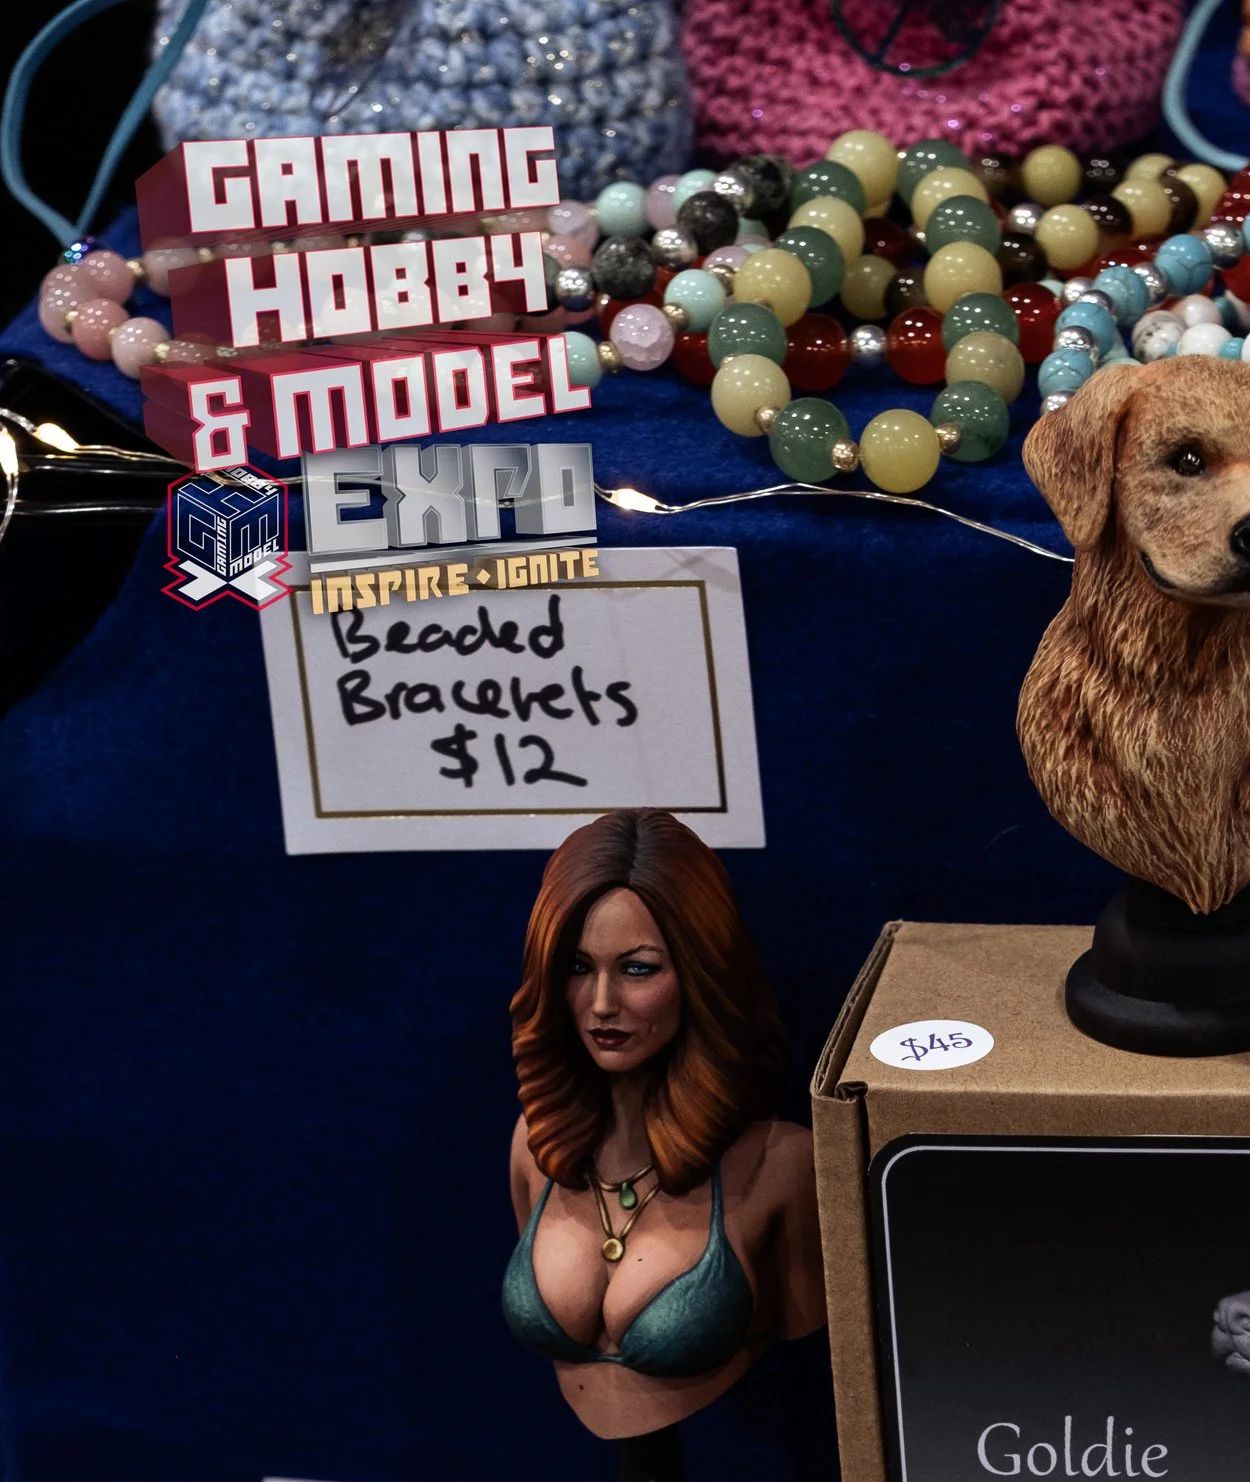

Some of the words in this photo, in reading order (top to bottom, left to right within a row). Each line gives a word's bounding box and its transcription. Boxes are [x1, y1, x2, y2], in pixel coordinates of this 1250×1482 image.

[331, 594, 564, 663] Beaded
[430, 723, 588, 788] $12
[900, 1032, 973, 1062] $45
[977, 1415, 1169, 1478] Goldie
